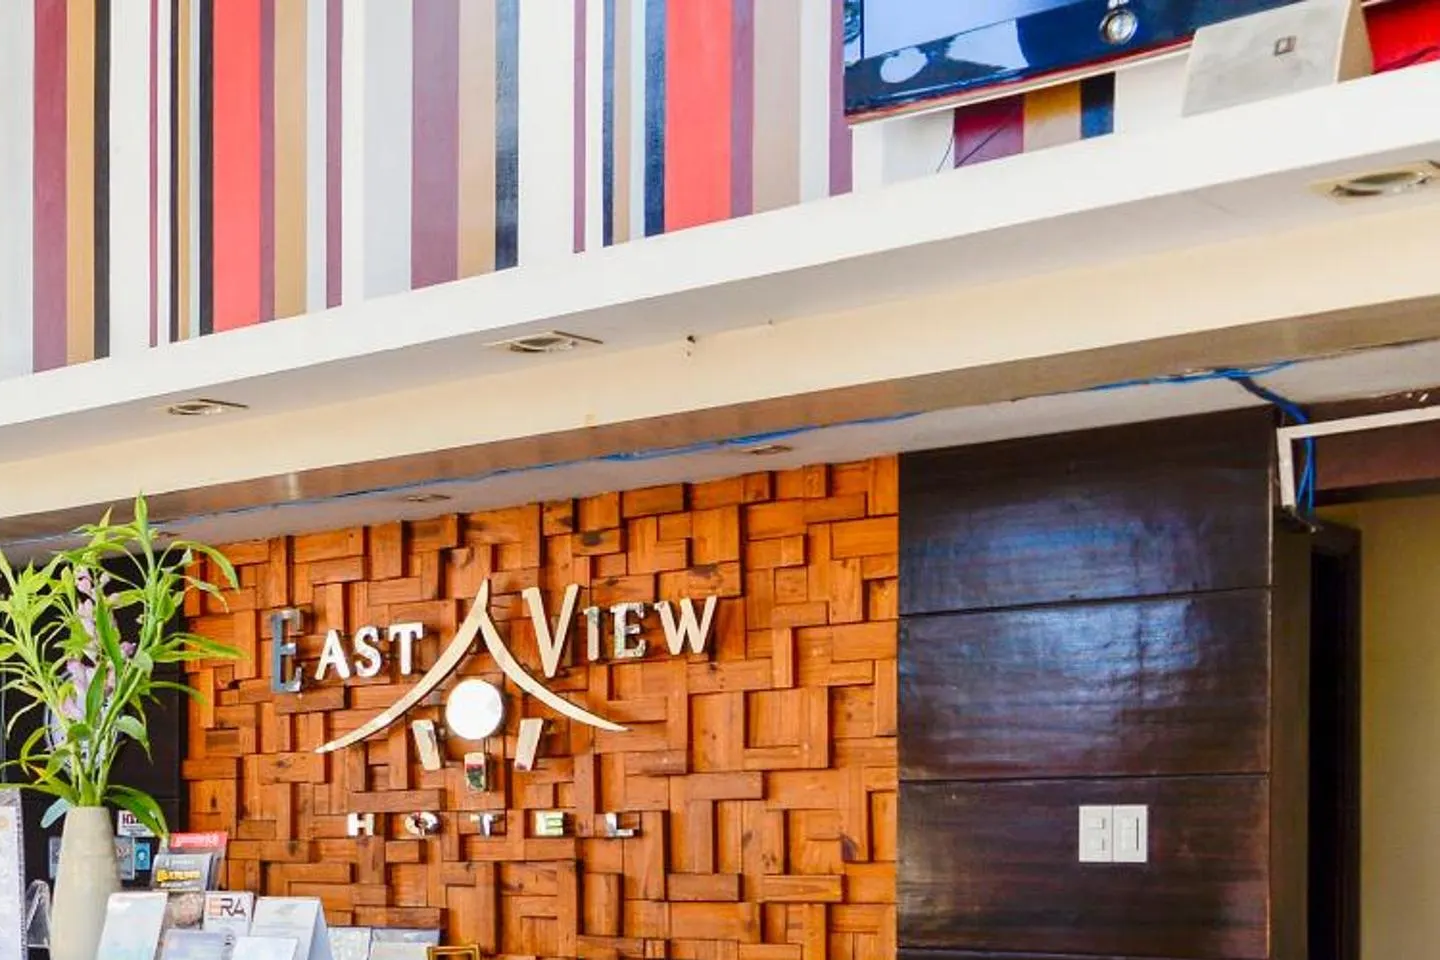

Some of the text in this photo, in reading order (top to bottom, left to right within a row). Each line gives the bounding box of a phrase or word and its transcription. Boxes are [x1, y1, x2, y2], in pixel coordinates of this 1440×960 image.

[269, 582, 718, 694] EAST VIEW
[346, 810, 640, 839] HOTEL
[207, 897, 247, 917] ERA
